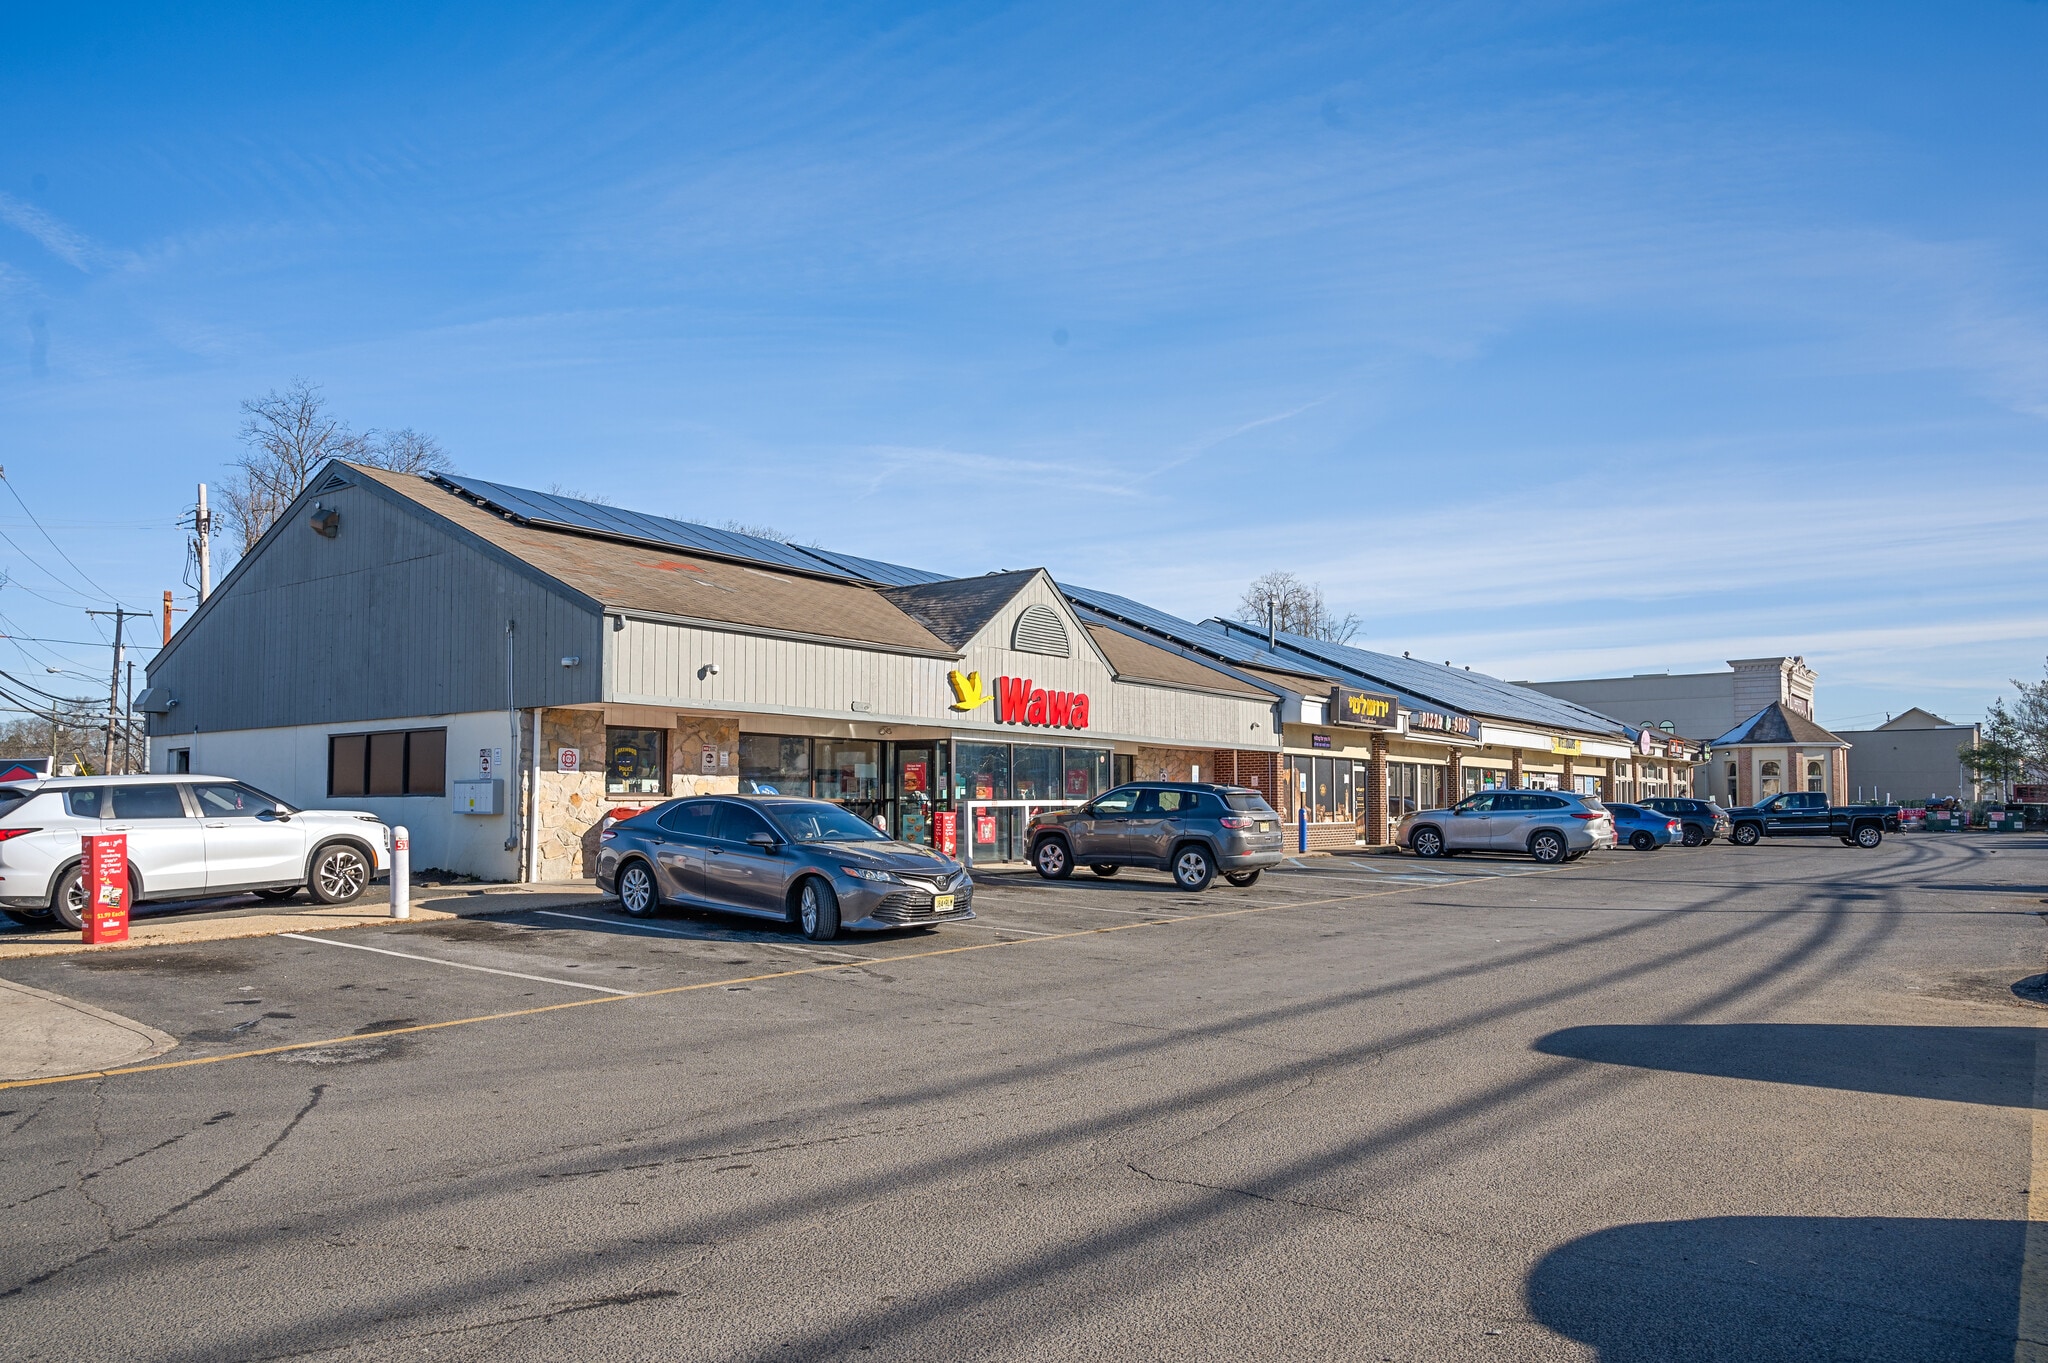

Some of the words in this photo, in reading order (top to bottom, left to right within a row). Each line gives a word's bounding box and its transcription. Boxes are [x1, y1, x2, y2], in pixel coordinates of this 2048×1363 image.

[998, 676, 1089, 728] Wawa
[1421, 711, 1443, 730] PIZZA
[1454, 716, 1470, 733] SUBS
[614, 747, 637, 755] LAKEWOOD
